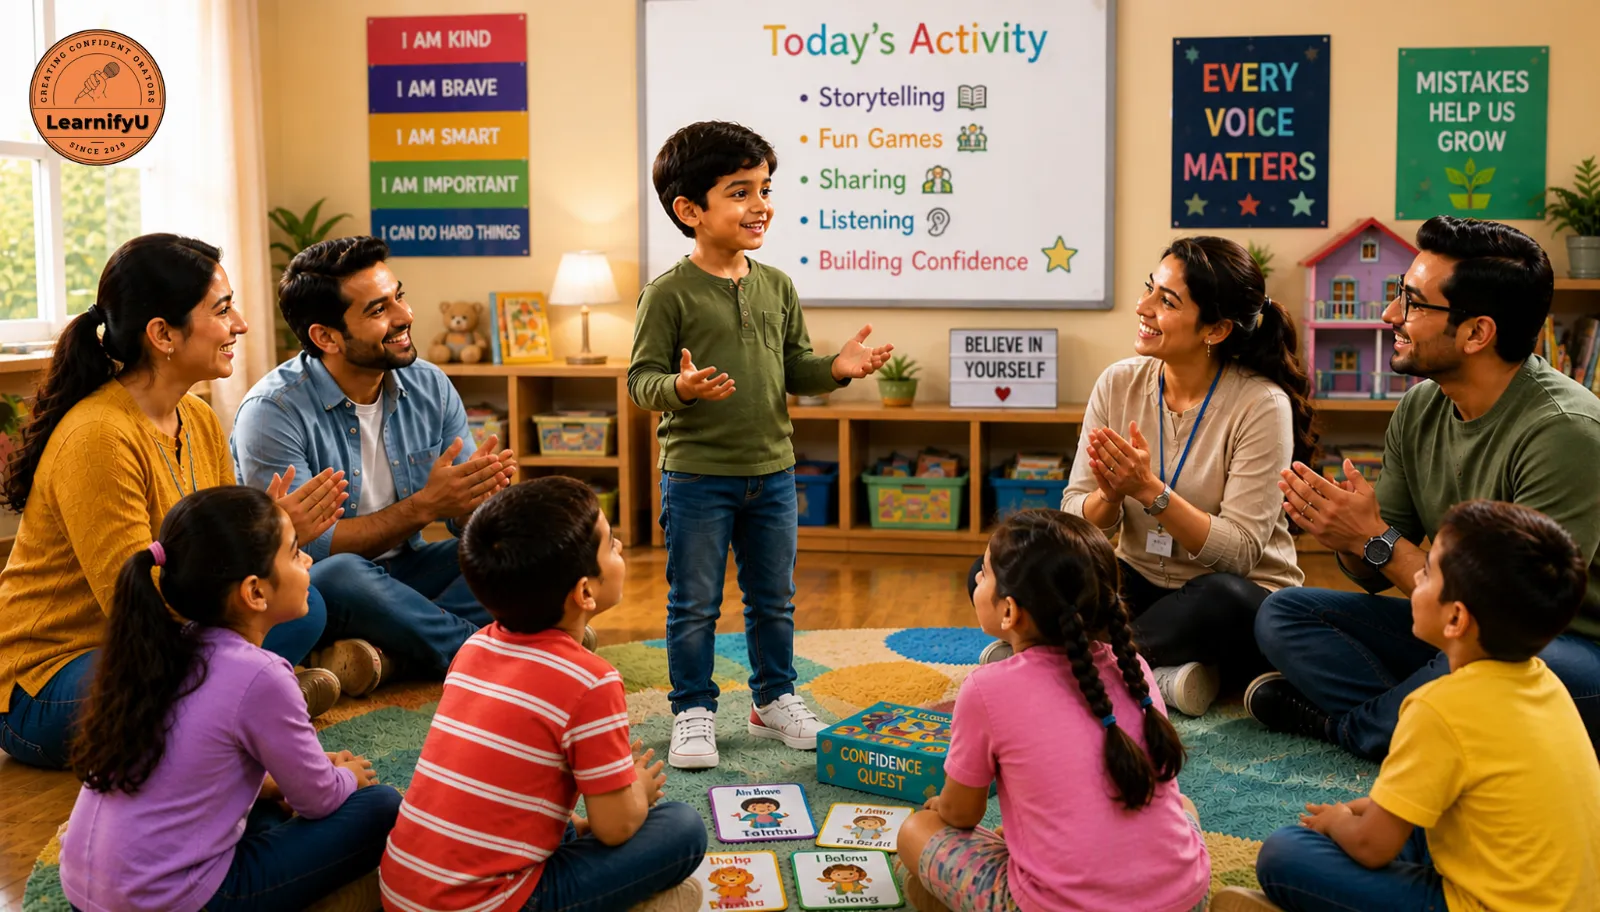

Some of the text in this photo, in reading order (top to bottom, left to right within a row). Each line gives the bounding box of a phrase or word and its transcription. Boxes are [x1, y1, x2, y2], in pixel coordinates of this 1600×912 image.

[402, 30, 491, 49] I AM KIND
[763, 22, 1048, 65] Today's Activity
[397, 78, 498, 98] I AM BRAVE
[1203, 62, 1299, 93] EVERY
[1416, 70, 1529, 94] MISTAKES
[819, 85, 945, 113] Storytelling
[1205, 107, 1295, 137] VOICE
[1429, 101, 1516, 123] HELP US
[396, 127, 500, 145] I AM SMART
[819, 127, 943, 149] Fun Games
[1437, 130, 1506, 152] GROW
[1183, 151, 1316, 181] MATTERS
[381, 175, 519, 194] I AM IMPORTANT
[819, 168, 906, 195] Sharing
[381, 224, 521, 241] I CAN DO HARD THINGS
[819, 209, 914, 236] Listening
[819, 250, 1028, 276] Building Confidence
[965, 336, 1043, 353] BELIEVE IN
[964, 361, 1046, 379] YOURSELF
[840, 746, 922, 775] CONFIDENCE
[857, 768, 906, 791] QUEST
